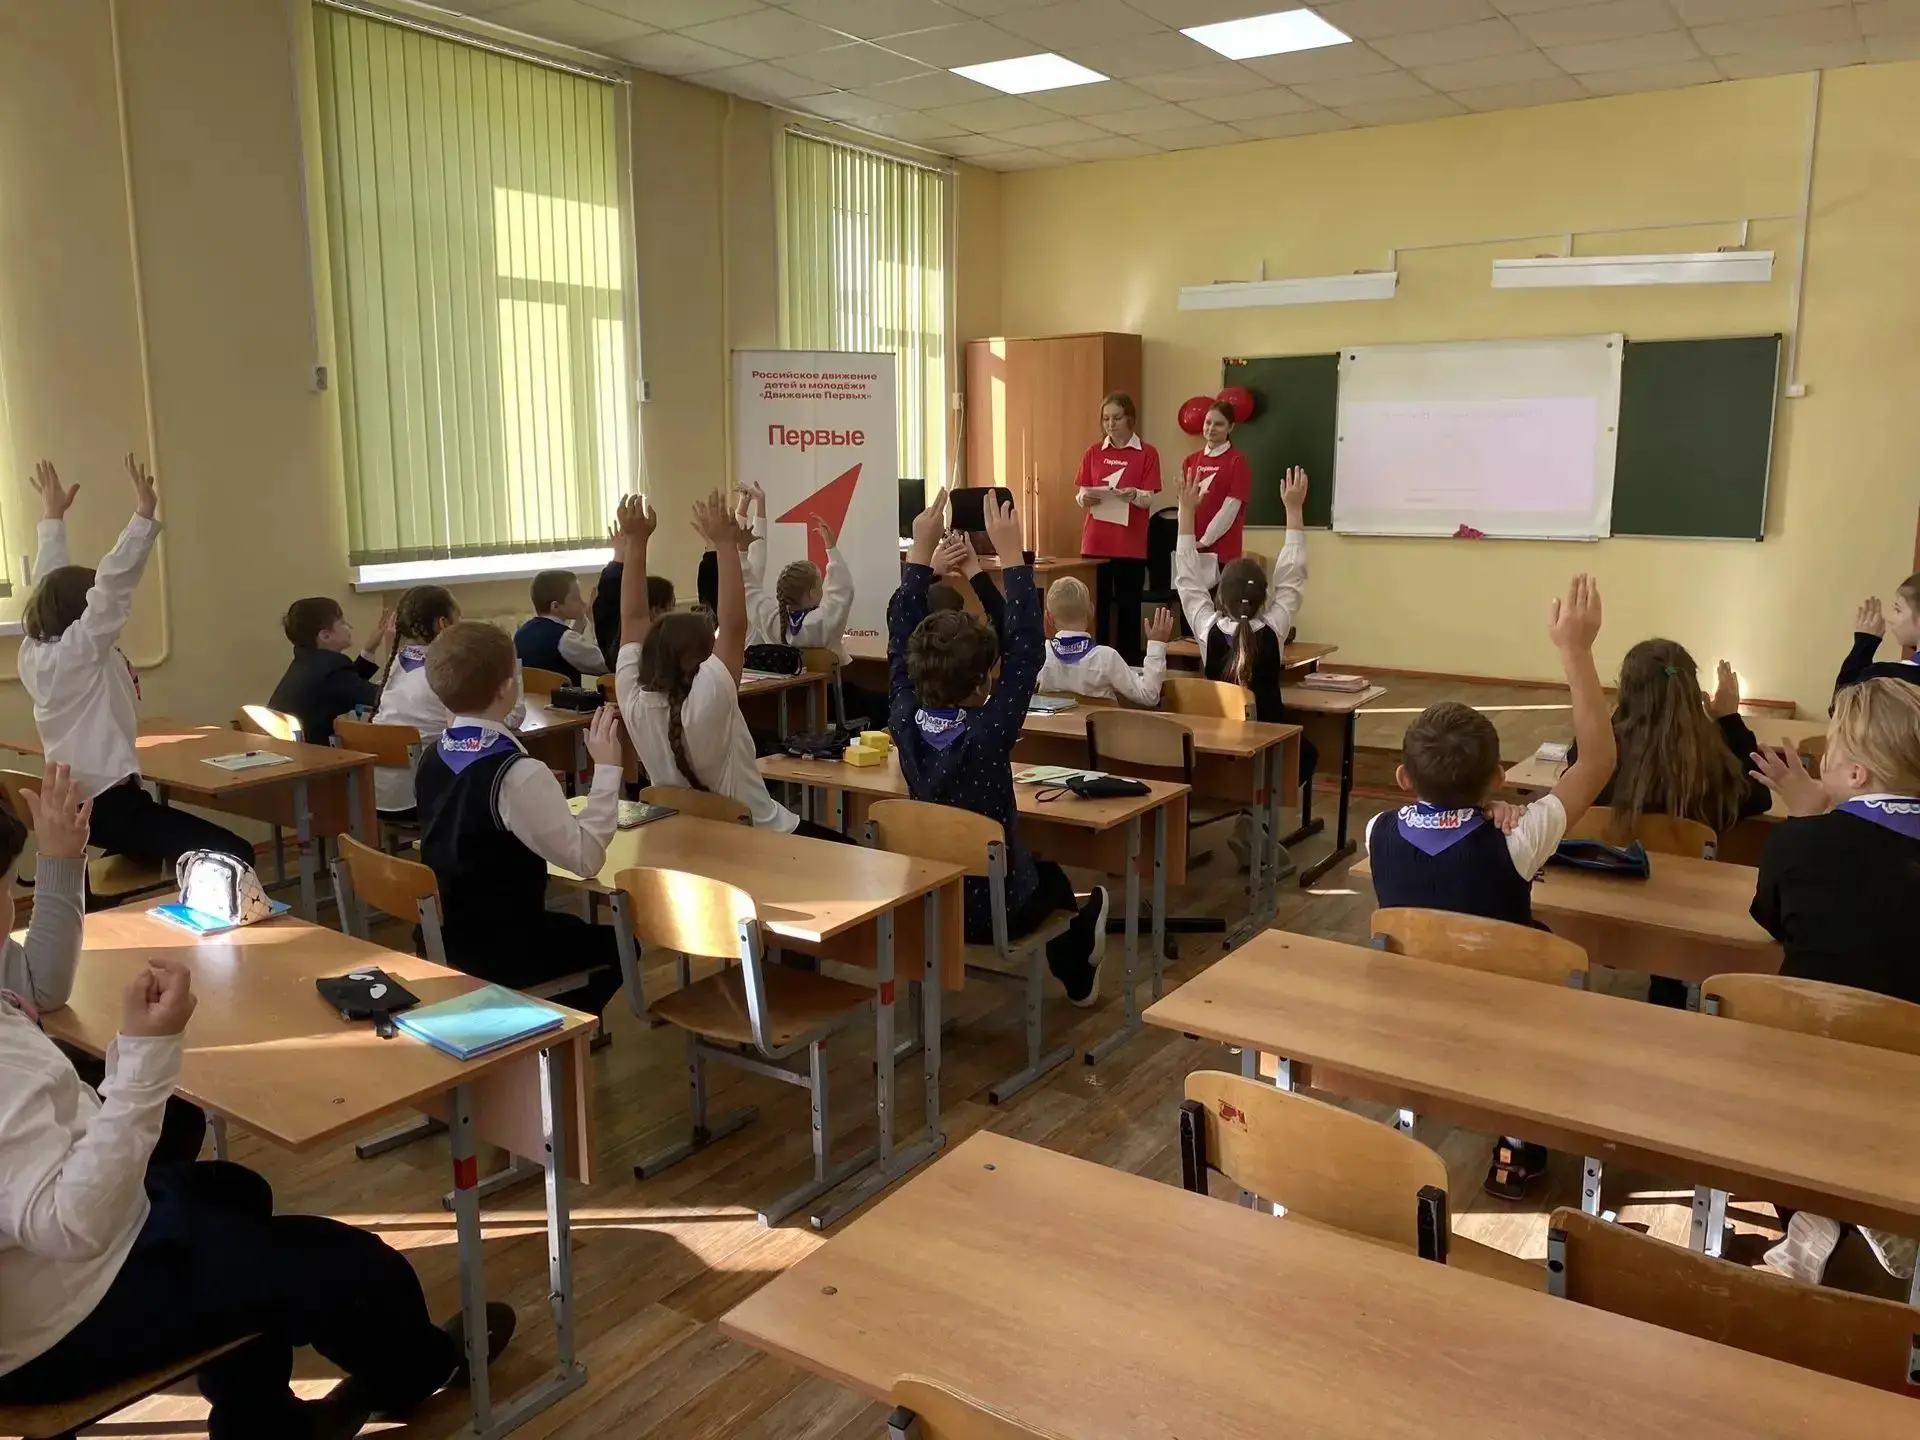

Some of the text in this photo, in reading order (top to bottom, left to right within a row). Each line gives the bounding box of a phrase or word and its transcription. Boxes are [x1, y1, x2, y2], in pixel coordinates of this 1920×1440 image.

[752, 370, 878, 380] Российское движение
[764, 381, 797, 390] детей
[799, 382, 807, 390] и
[768, 424, 865, 453] Первые
